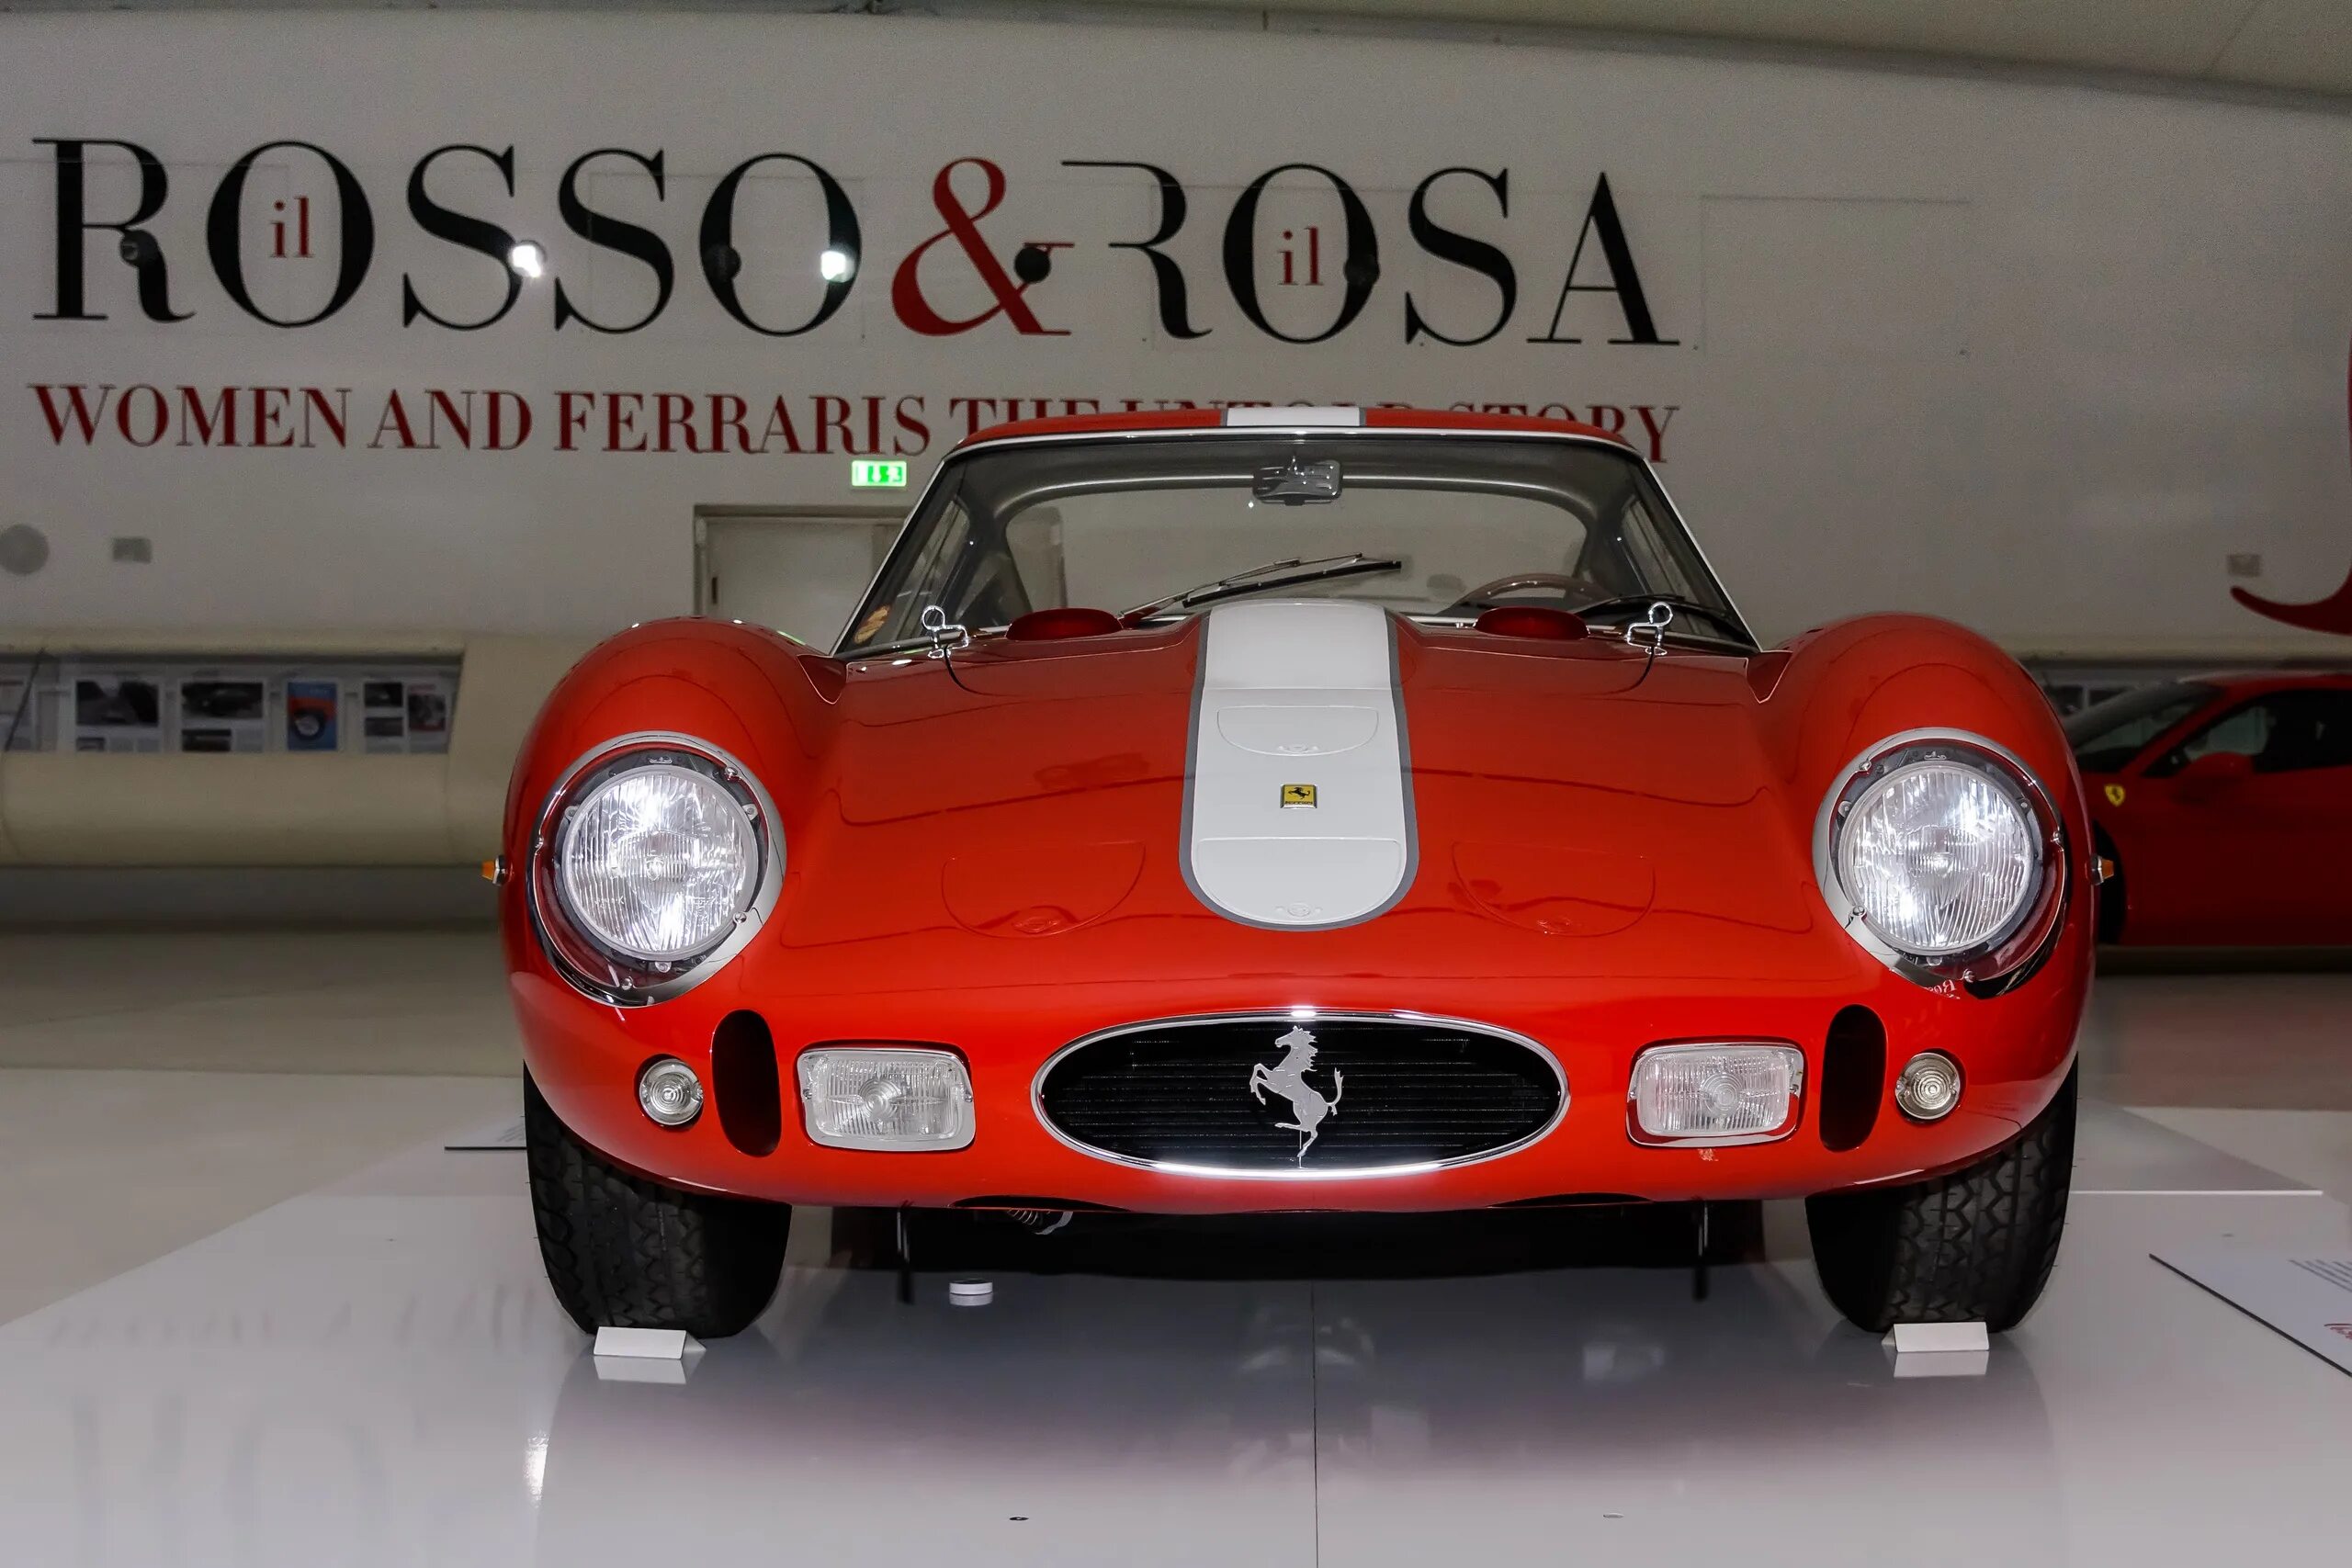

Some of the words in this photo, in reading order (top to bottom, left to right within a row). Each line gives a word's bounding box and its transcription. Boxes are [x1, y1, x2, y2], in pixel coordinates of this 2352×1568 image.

[32, 138, 863, 338] ROSSO
[891, 157, 1074, 337] &
[1061, 161, 1680, 347] ROSA
[269, 197, 313, 258] il
[1278, 226, 1323, 286] il
[28, 383, 350, 449] WOMEN
[368, 389, 533, 451] AND
[554, 390, 930, 457] FERRARIS
